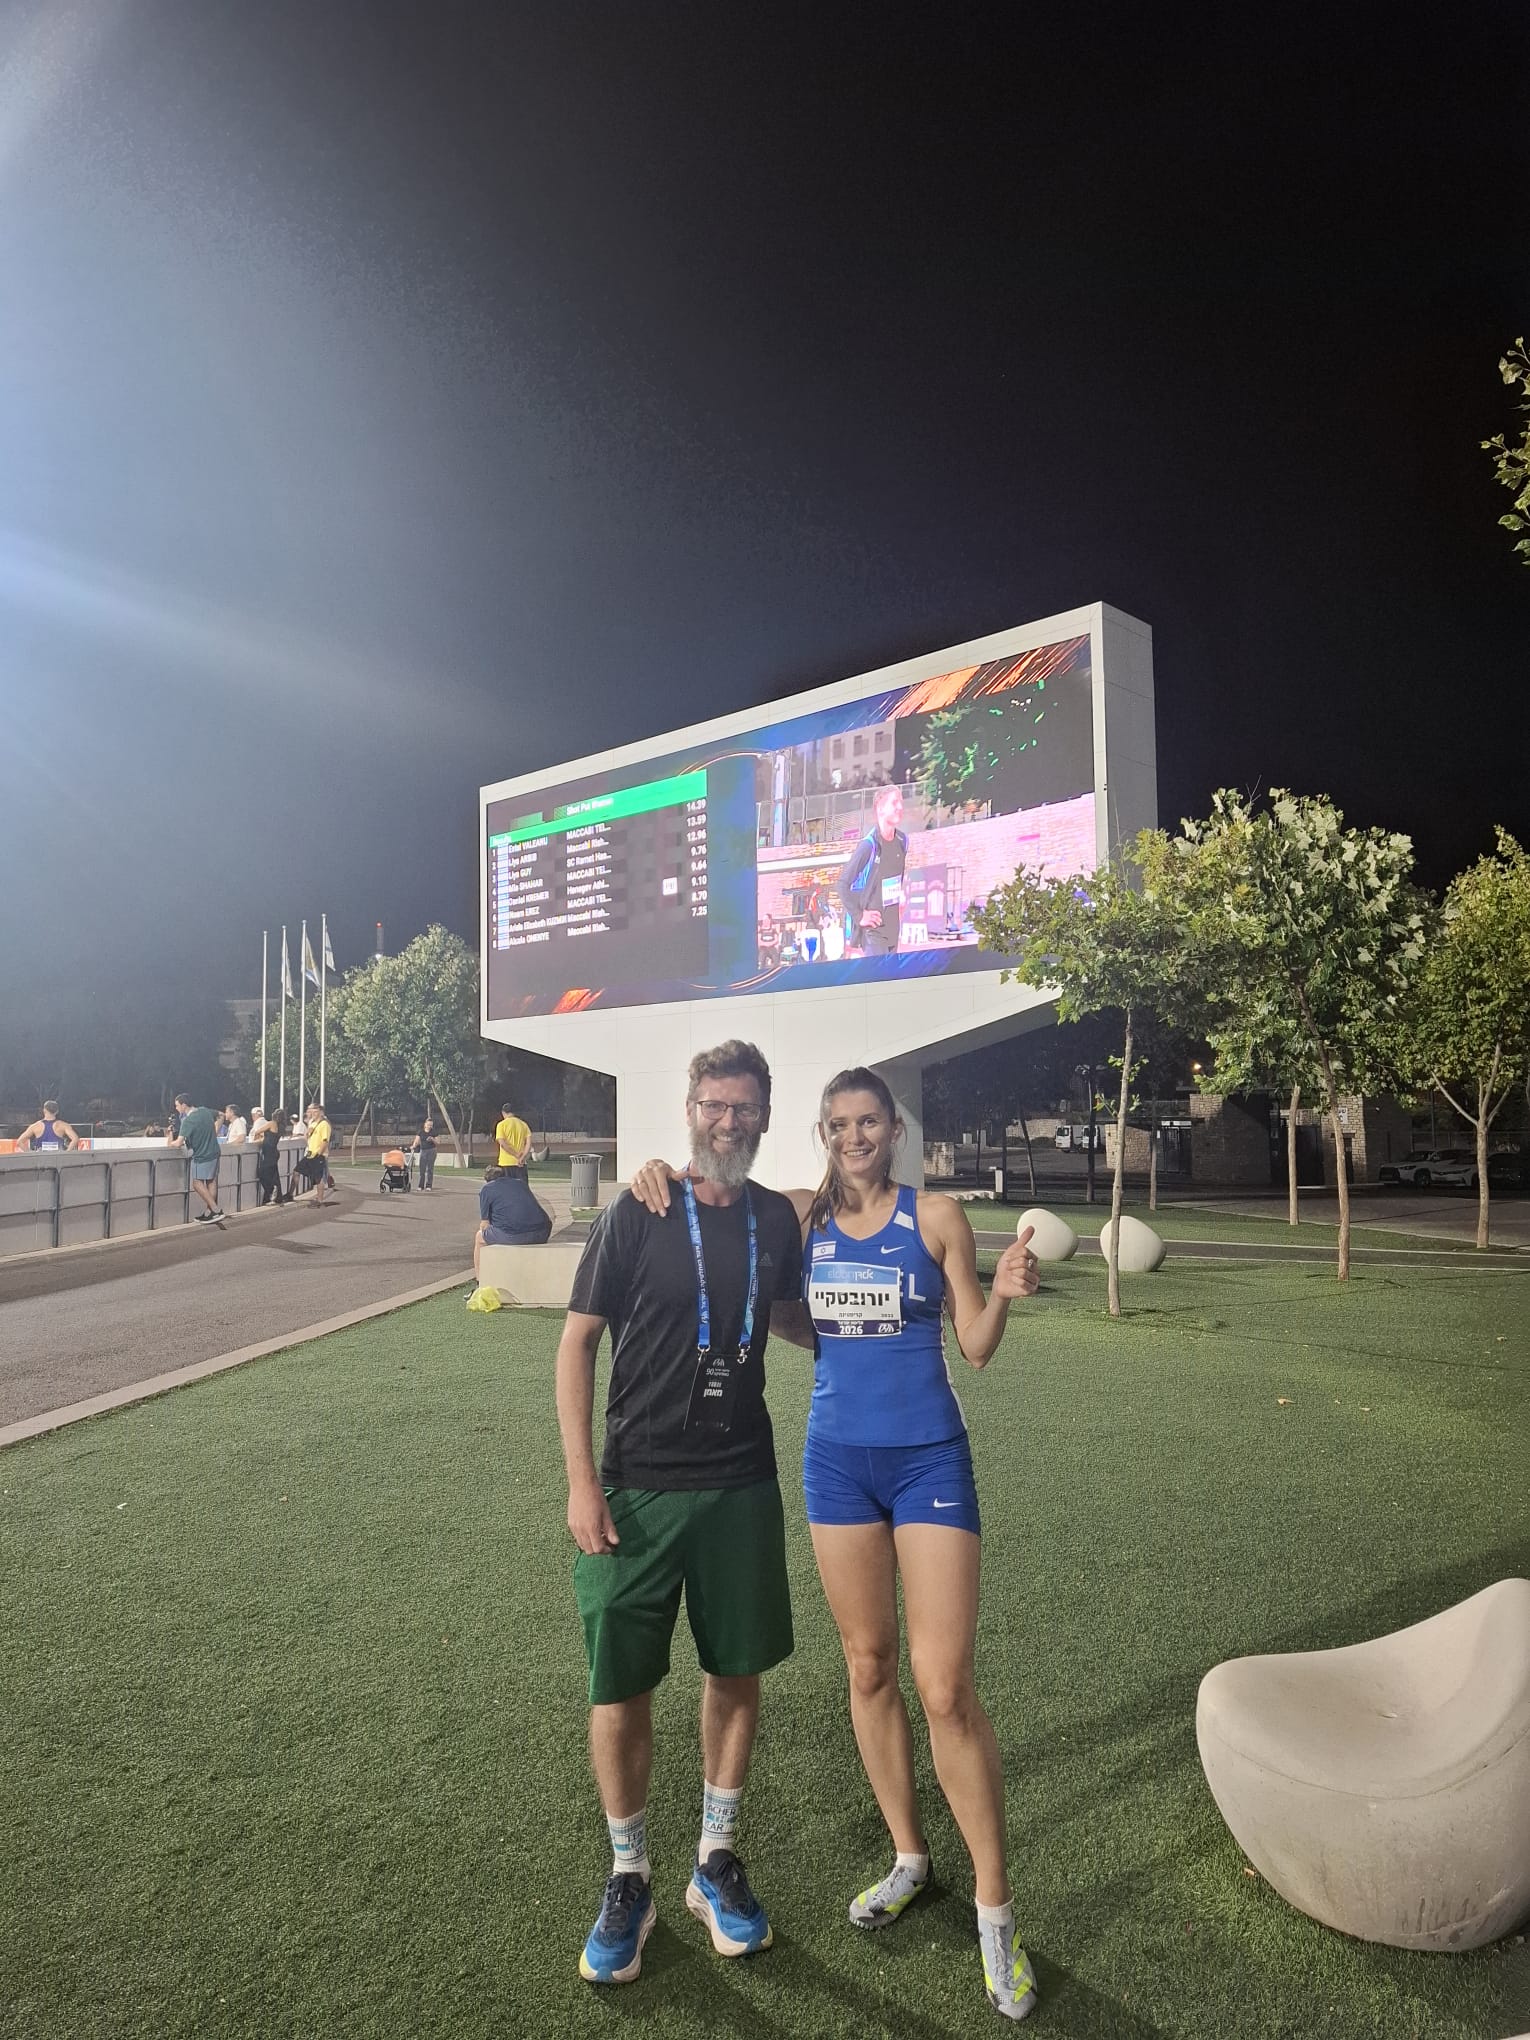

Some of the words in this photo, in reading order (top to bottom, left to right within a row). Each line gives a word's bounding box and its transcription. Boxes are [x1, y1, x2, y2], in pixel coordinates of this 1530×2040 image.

[566, 826, 594, 840] MACCABI
[566, 857, 576, 868] SC
[566, 868, 594, 881] MACCABI
[567, 896, 594, 908] MACCABI
[839, 1325, 864, 1335] 2026
